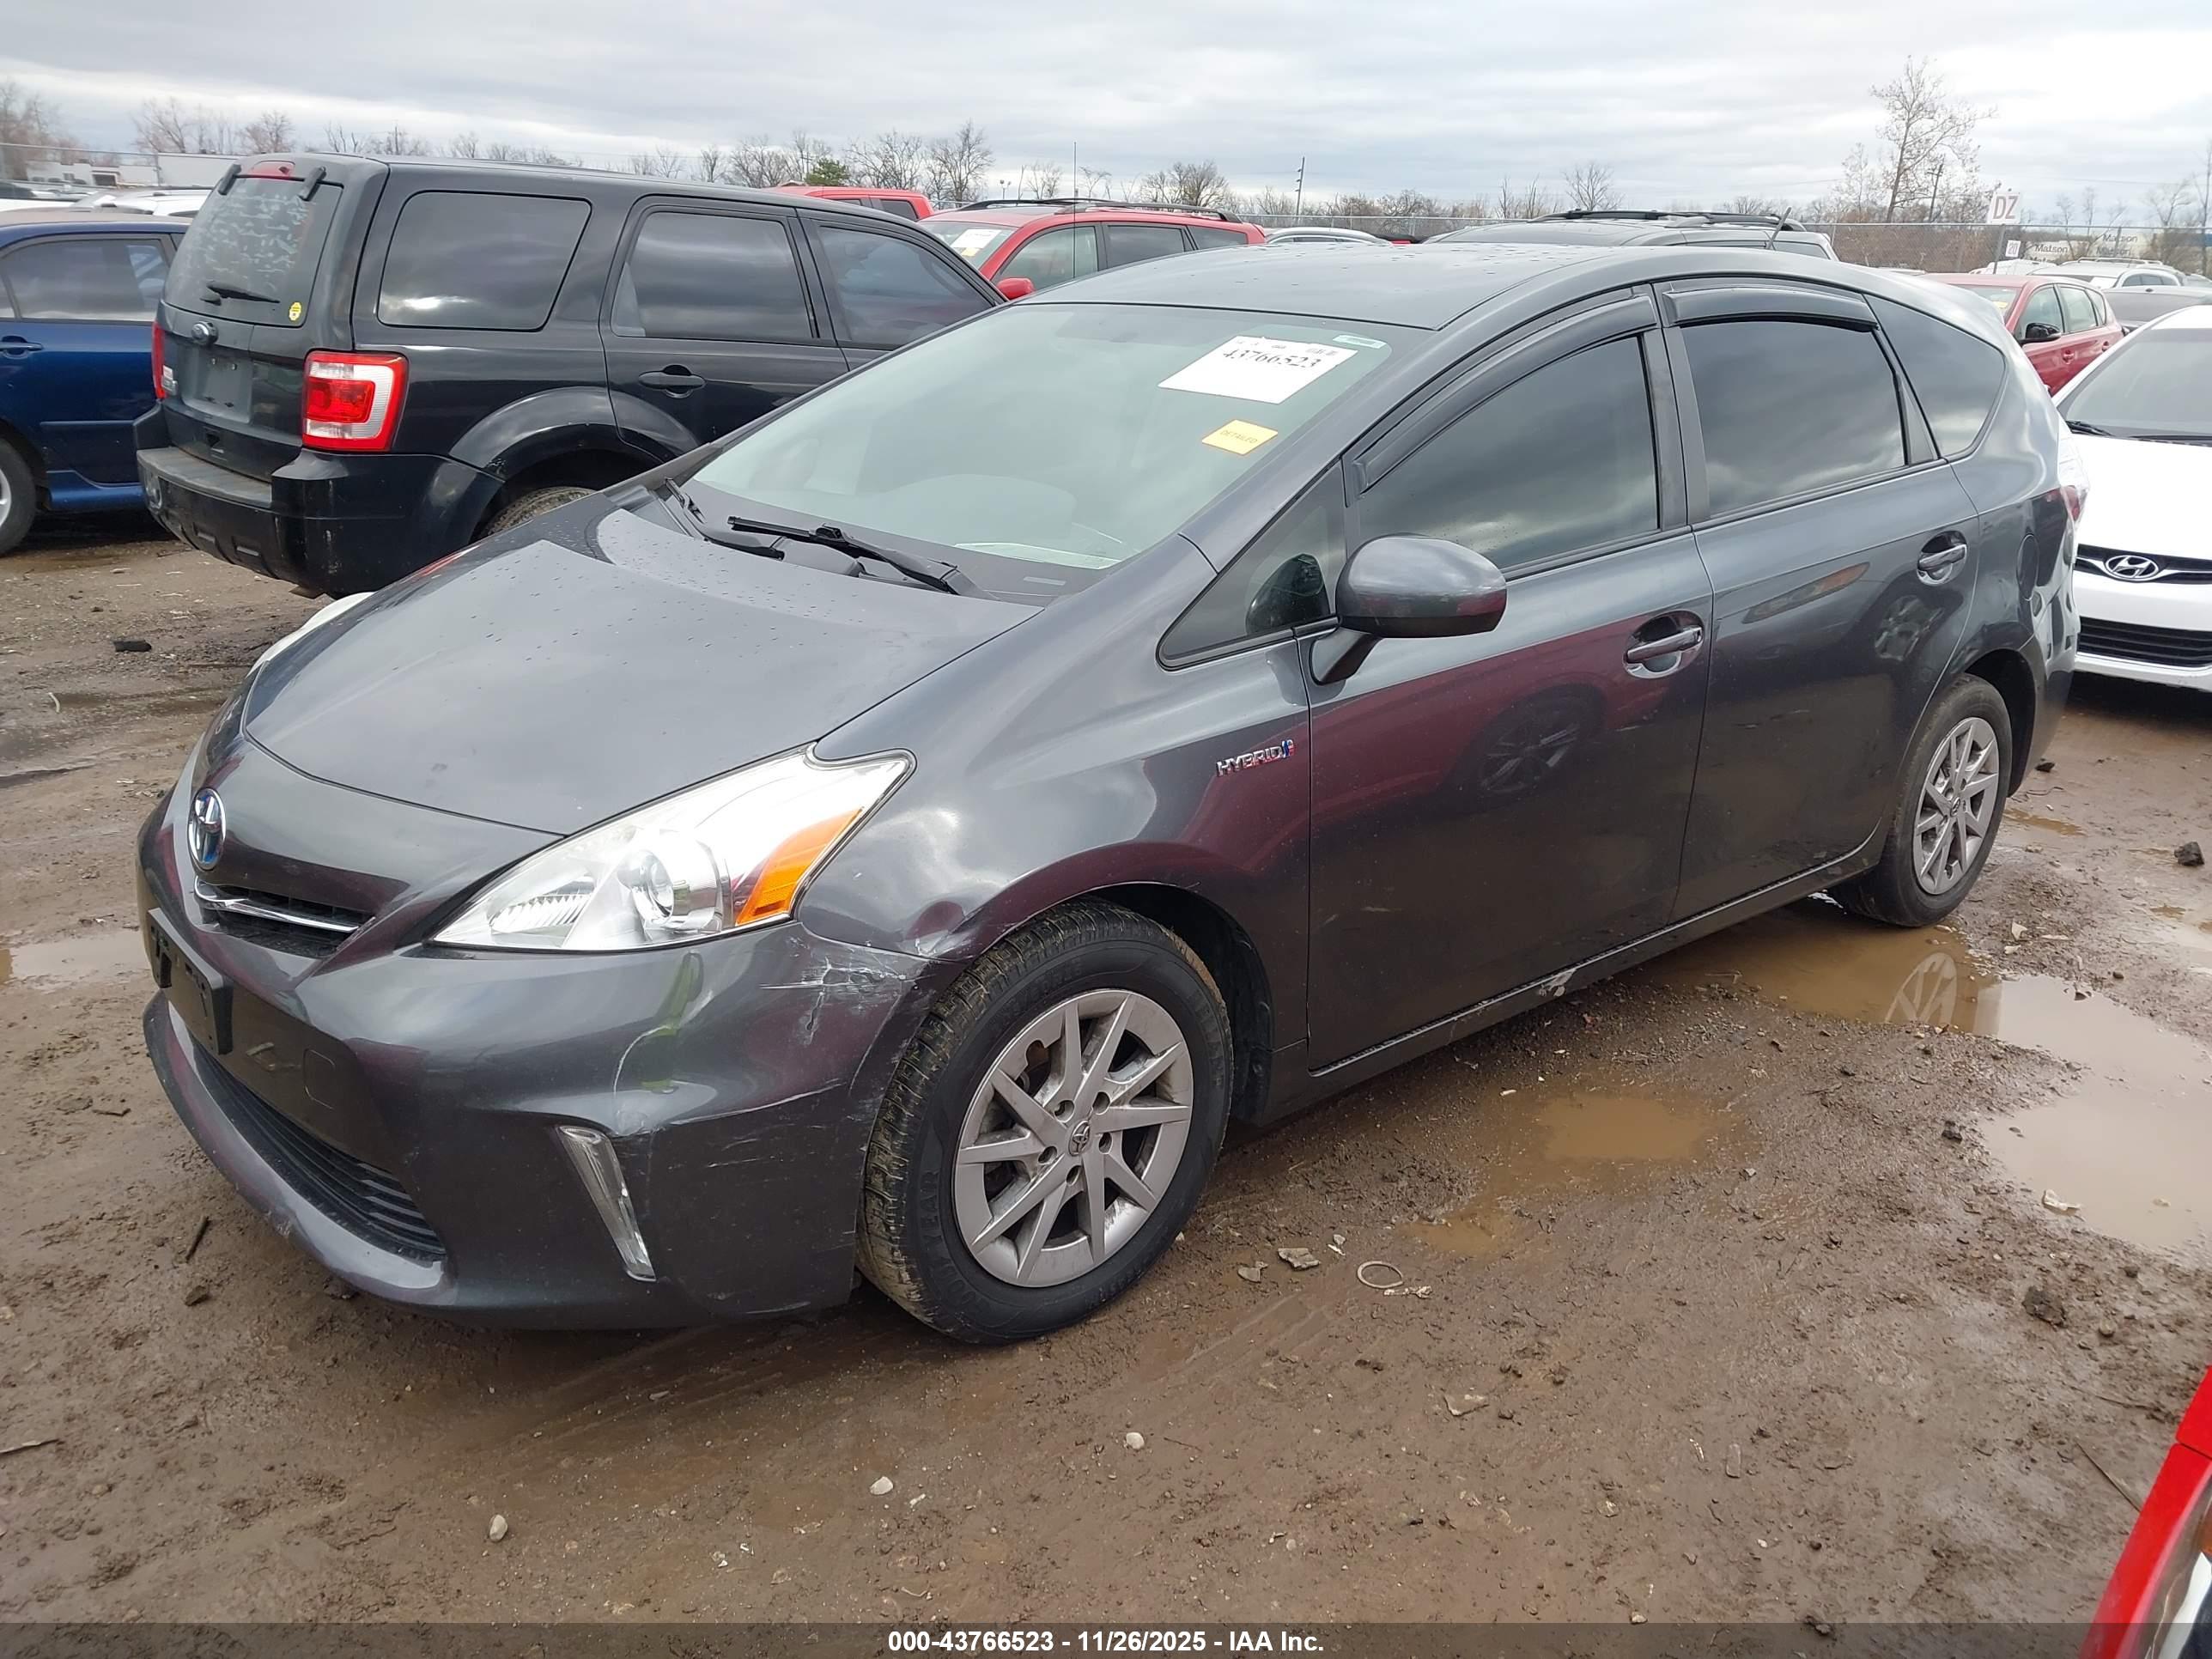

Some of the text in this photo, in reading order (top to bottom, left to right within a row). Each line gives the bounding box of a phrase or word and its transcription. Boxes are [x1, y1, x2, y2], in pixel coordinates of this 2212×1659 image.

[1992, 195, 2019, 220] DZ
[2034, 244, 2068, 253] Matson
[1223, 349, 1322, 368] 43766523
[1216, 746, 1284, 777] HYBRID
